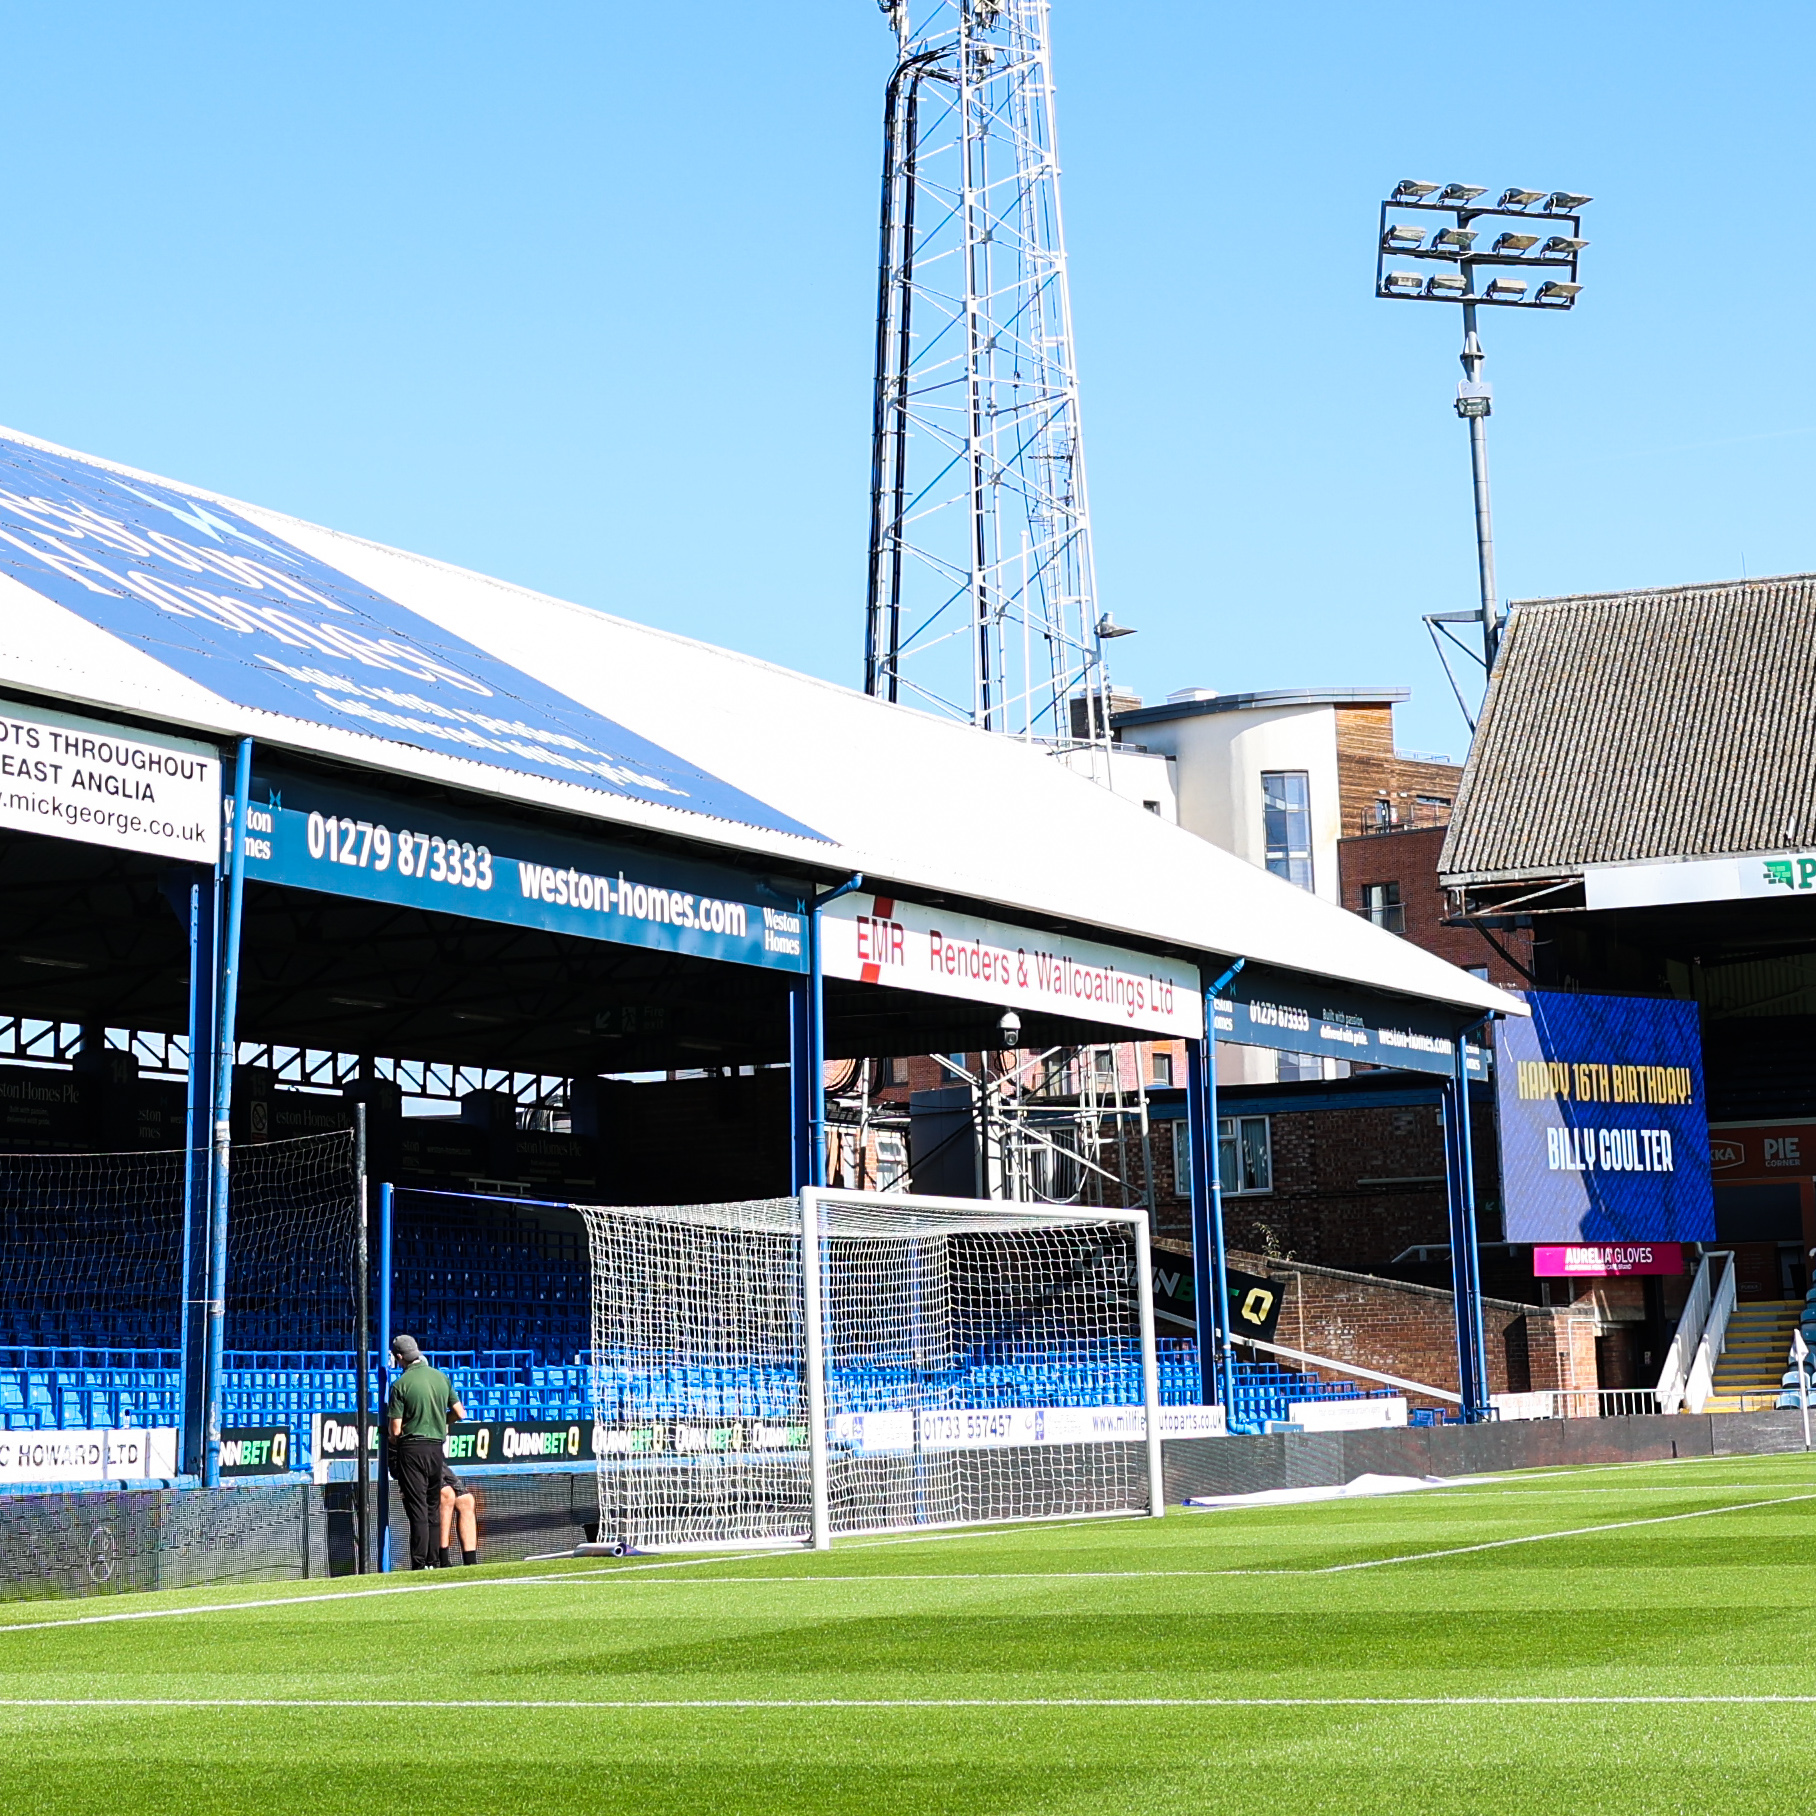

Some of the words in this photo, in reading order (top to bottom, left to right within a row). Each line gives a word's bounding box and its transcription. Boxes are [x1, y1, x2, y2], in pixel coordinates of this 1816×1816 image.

[48, 731, 209, 783] THROUGHOUT
[1, 754, 64, 783] EAST
[71, 768, 157, 804] ANGLIA
[307, 811, 392, 872] 01279
[398, 828, 493, 891] 873333
[519, 863, 747, 938] weston-homes.com
[763, 906, 801, 934] Weston
[764, 929, 801, 956] Homes
[856, 916, 905, 967] EMR
[929, 929, 1010, 984] Renders
[1016, 946, 1029, 989] &
[1034, 949, 1144, 1018] Wallcoatings
[1150, 976, 1174, 1016] Ltd
[1378, 1027, 1452, 1055] weston-homes.com
[22, 1080, 61, 1103] Homes
[63, 1083, 80, 1104] Plc
[1517, 1061, 1570, 1101] HAPPY
[1572, 1063, 1609, 1103] 16TH
[1613, 1065, 1692, 1105] BIRTHDAY!
[303, 1110, 335, 1129] Homes
[1547, 1127, 1596, 1171] BILLY
[1598, 1128, 1673, 1171] COULTER
[1764, 1137, 1800, 1160] PIE
[1765, 1159, 1800, 1167] CORNER
[1614, 1248, 1653, 1263] GLOVES
[1240, 1286, 1274, 1326] Q
[502, 1427, 566, 1457] QUINNBET
[924, 1416, 960, 1441] 01733
[967, 1415, 1012, 1439] 557457
[18, 1444, 100, 1467] HOWARD
[107, 1444, 138, 1465] LTD
